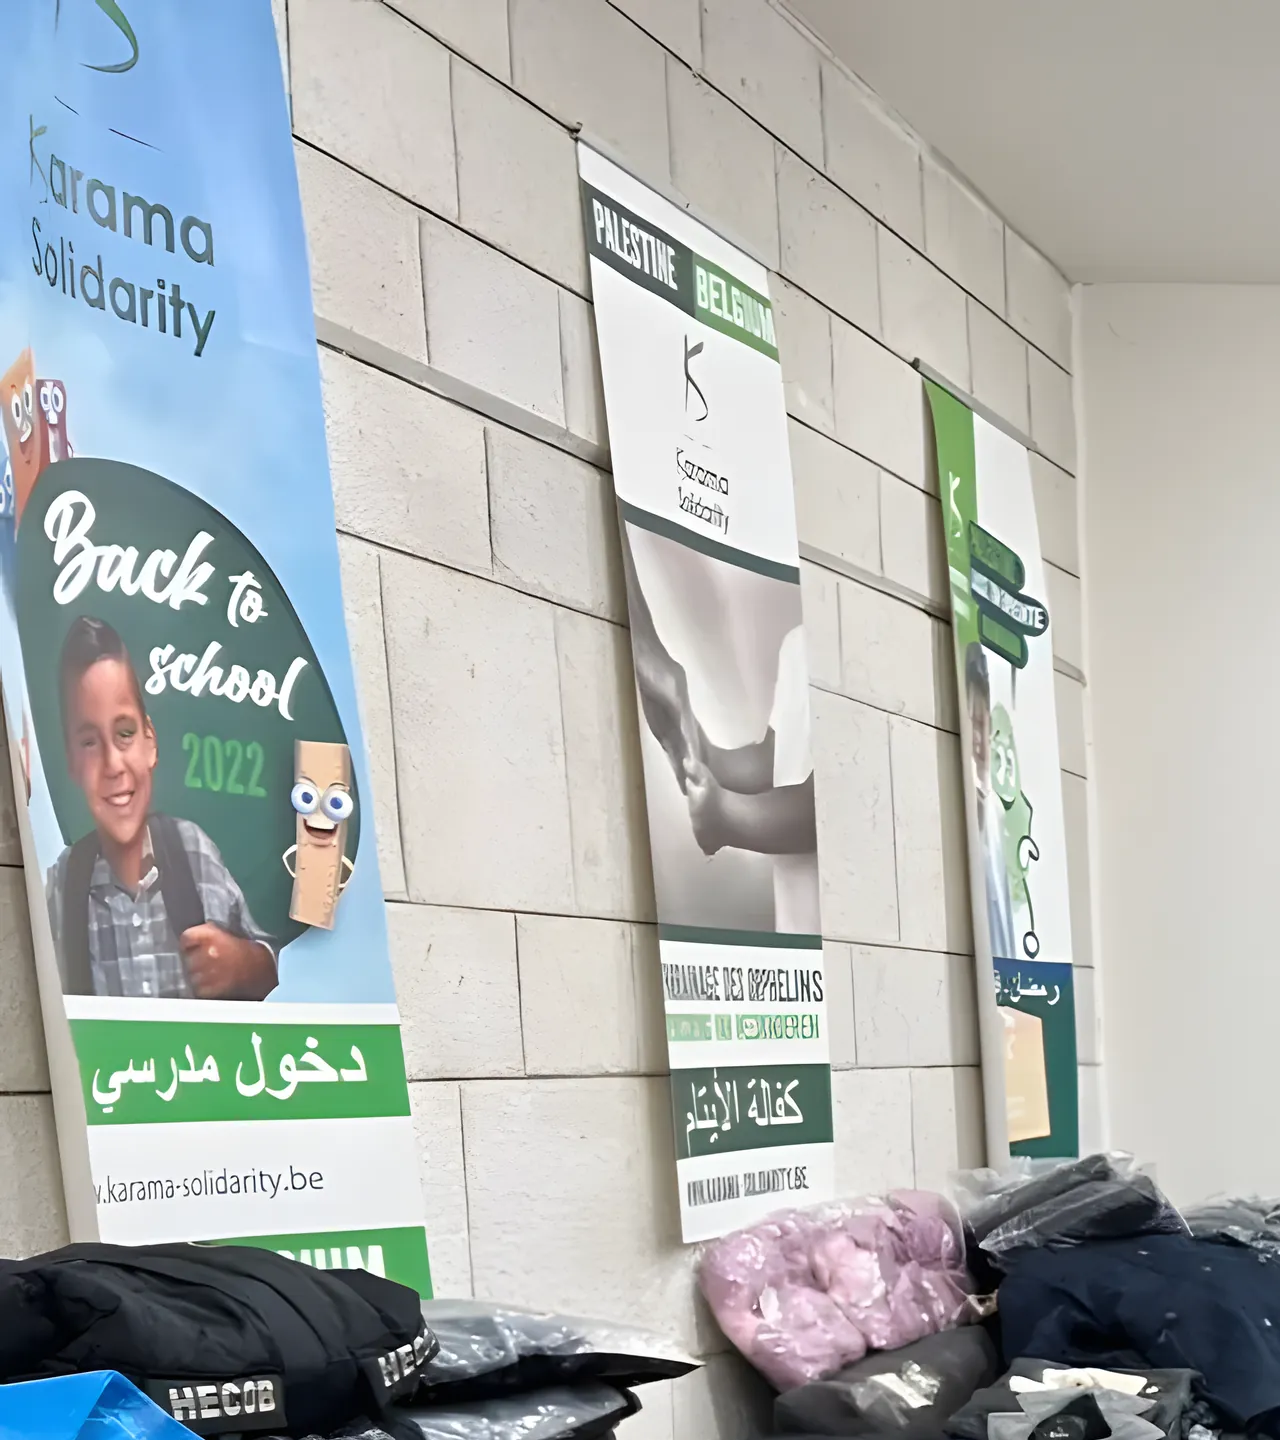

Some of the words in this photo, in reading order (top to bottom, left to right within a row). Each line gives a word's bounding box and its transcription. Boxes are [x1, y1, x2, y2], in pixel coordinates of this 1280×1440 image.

[29, 114, 215, 267] Karama
[31, 216, 216, 358] Solidarity
[592, 198, 678, 290] PALESTINE
[696, 264, 778, 348] BELGIUM
[43, 489, 216, 611] Back
[227, 570, 269, 628] to
[144, 640, 309, 721] school
[181, 732, 268, 798] 2022
[92, 1044, 220, 1113] مدرسي
[235, 1031, 368, 1100] دخول
[747, 1078, 804, 1126] كفالة
